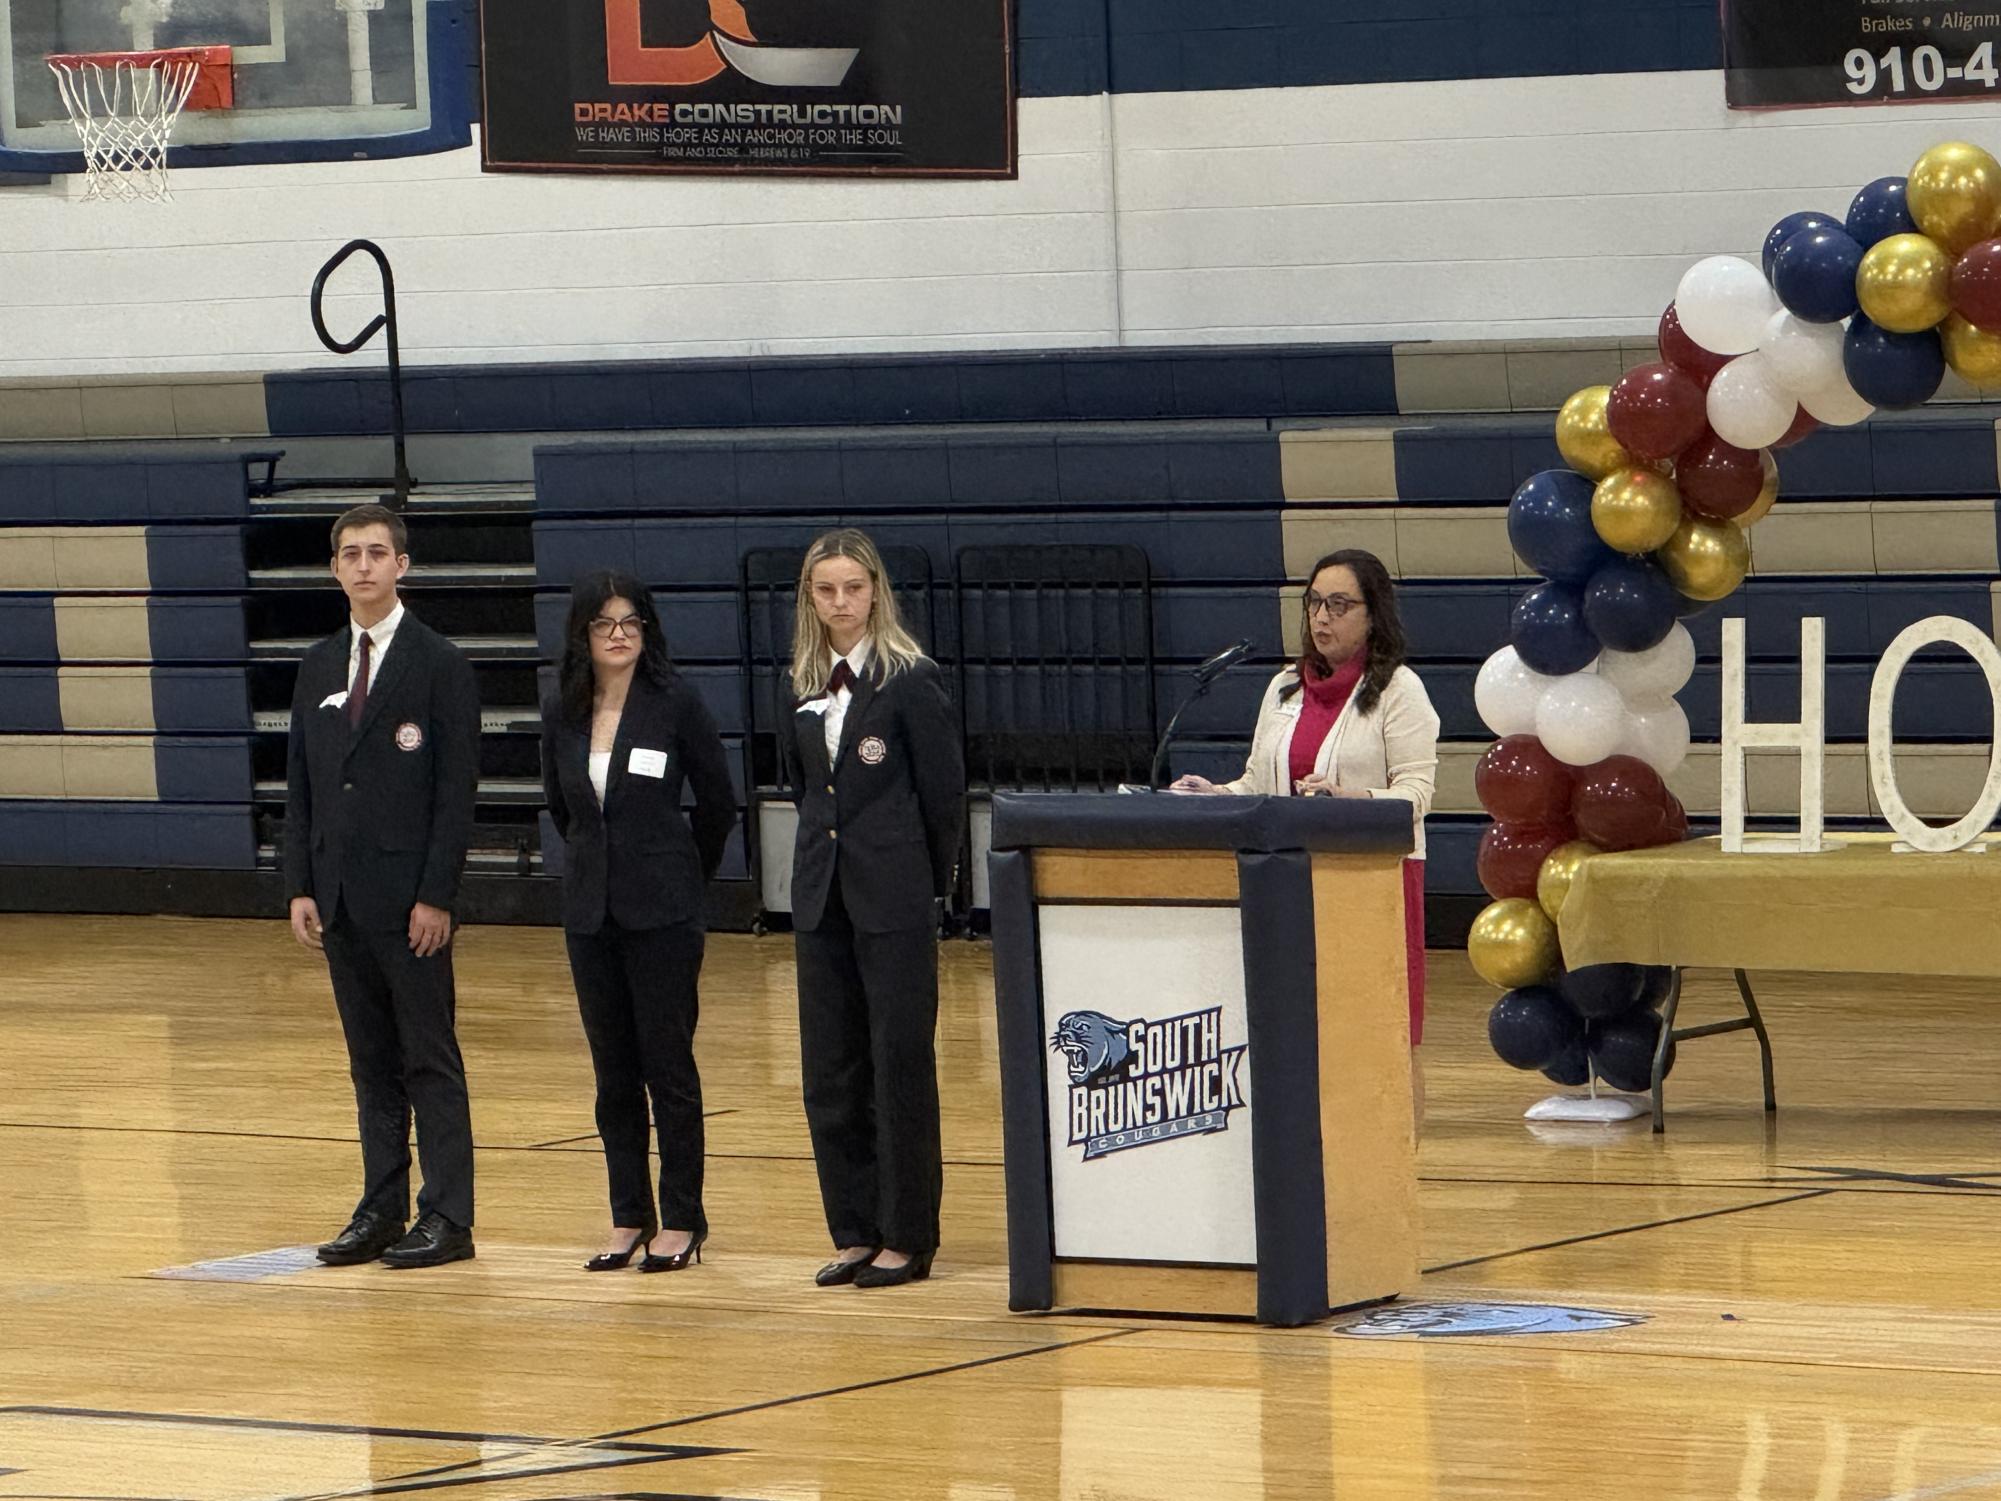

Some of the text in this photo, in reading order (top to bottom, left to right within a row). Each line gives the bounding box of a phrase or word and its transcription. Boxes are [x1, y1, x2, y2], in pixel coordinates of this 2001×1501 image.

[1861, 15, 1913, 32] Brakes
[1843, 42, 1999, 94] 910-4
[574, 103, 902, 125] DRAKE CONSTRUCTION
[575, 127, 902, 145] WE HAVE THIS HOPE AS AN ANCHOR FOR THE SOUL
[1128, 1011, 1219, 1078] SOUTH
[1072, 1050, 1241, 1142] BRUNSWICK
[1098, 1114, 1213, 1149] COUGARS
